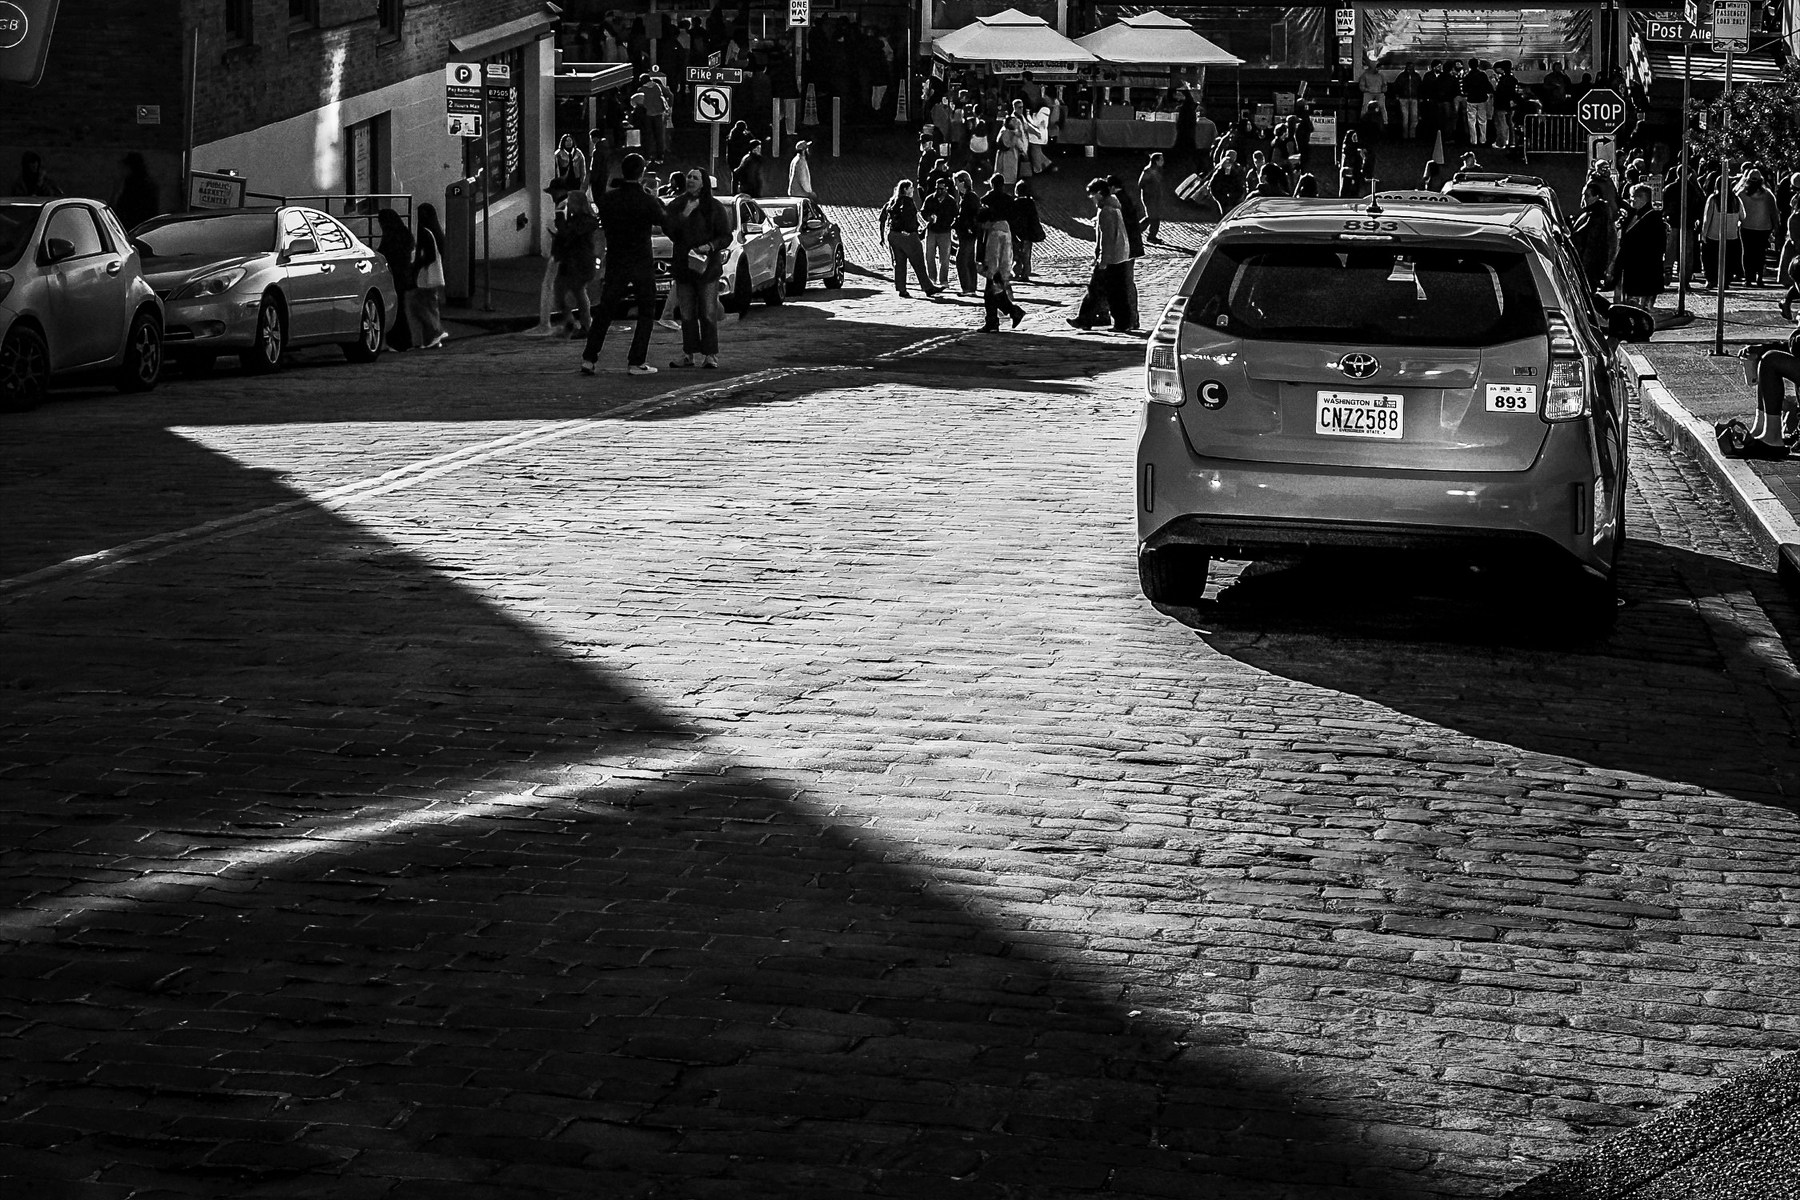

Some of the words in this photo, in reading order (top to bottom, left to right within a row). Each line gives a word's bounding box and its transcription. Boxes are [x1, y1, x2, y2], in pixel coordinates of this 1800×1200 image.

[1651, 23, 1683, 39] Post
[1690, 28, 1712, 40] Alle
[460, 69, 469, 80] P
[690, 68, 712, 80] Pike
[716, 72, 724, 80] Pl
[448, 100, 454, 108] 2
[1581, 104, 1622, 120] STOP
[1343, 220, 1398, 231] 893
[1202, 383, 1219, 403] C
[1324, 398, 1370, 406] WASHINGTON
[1495, 395, 1527, 409] 893
[1321, 407, 1398, 430] CNZ2588
